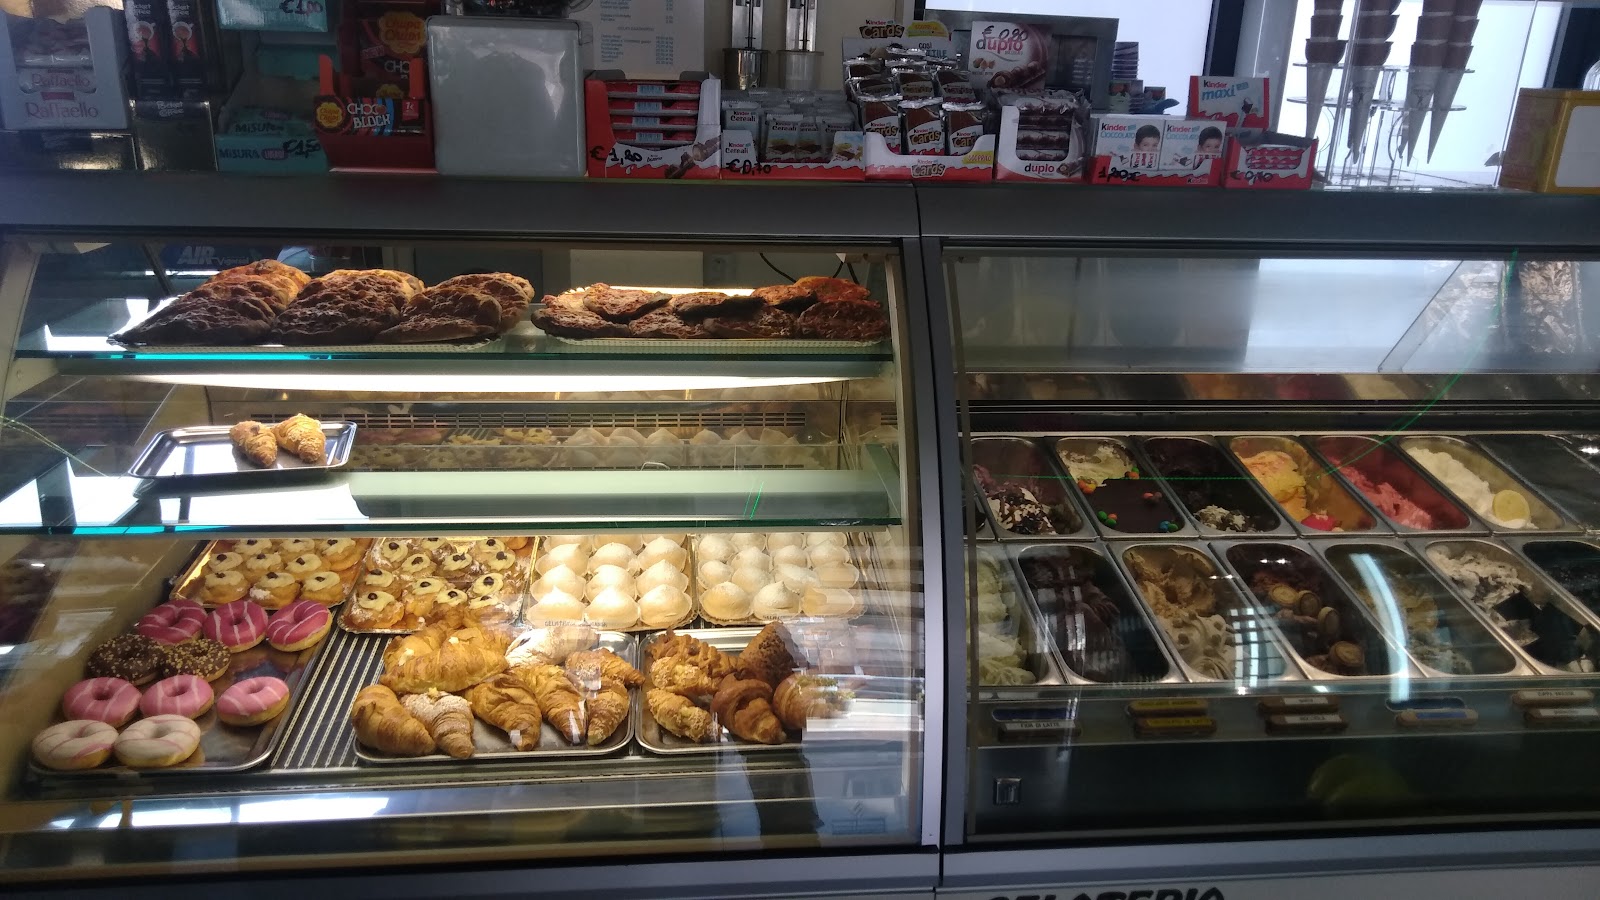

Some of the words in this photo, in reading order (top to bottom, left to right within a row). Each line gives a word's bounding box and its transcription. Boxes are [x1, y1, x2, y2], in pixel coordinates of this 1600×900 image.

[976, 37, 1023, 54] duplo
[32, 73, 91, 87] Raffaello
[1202, 85, 1236, 100] maxi
[25, 102, 99, 119] Raffaello
[352, 114, 391, 129] BLOCK
[911, 131, 940, 144] Cards
[912, 164, 945, 176] Cards
[1024, 163, 1055, 174] duplo
[177, 246, 216, 265] AIR
